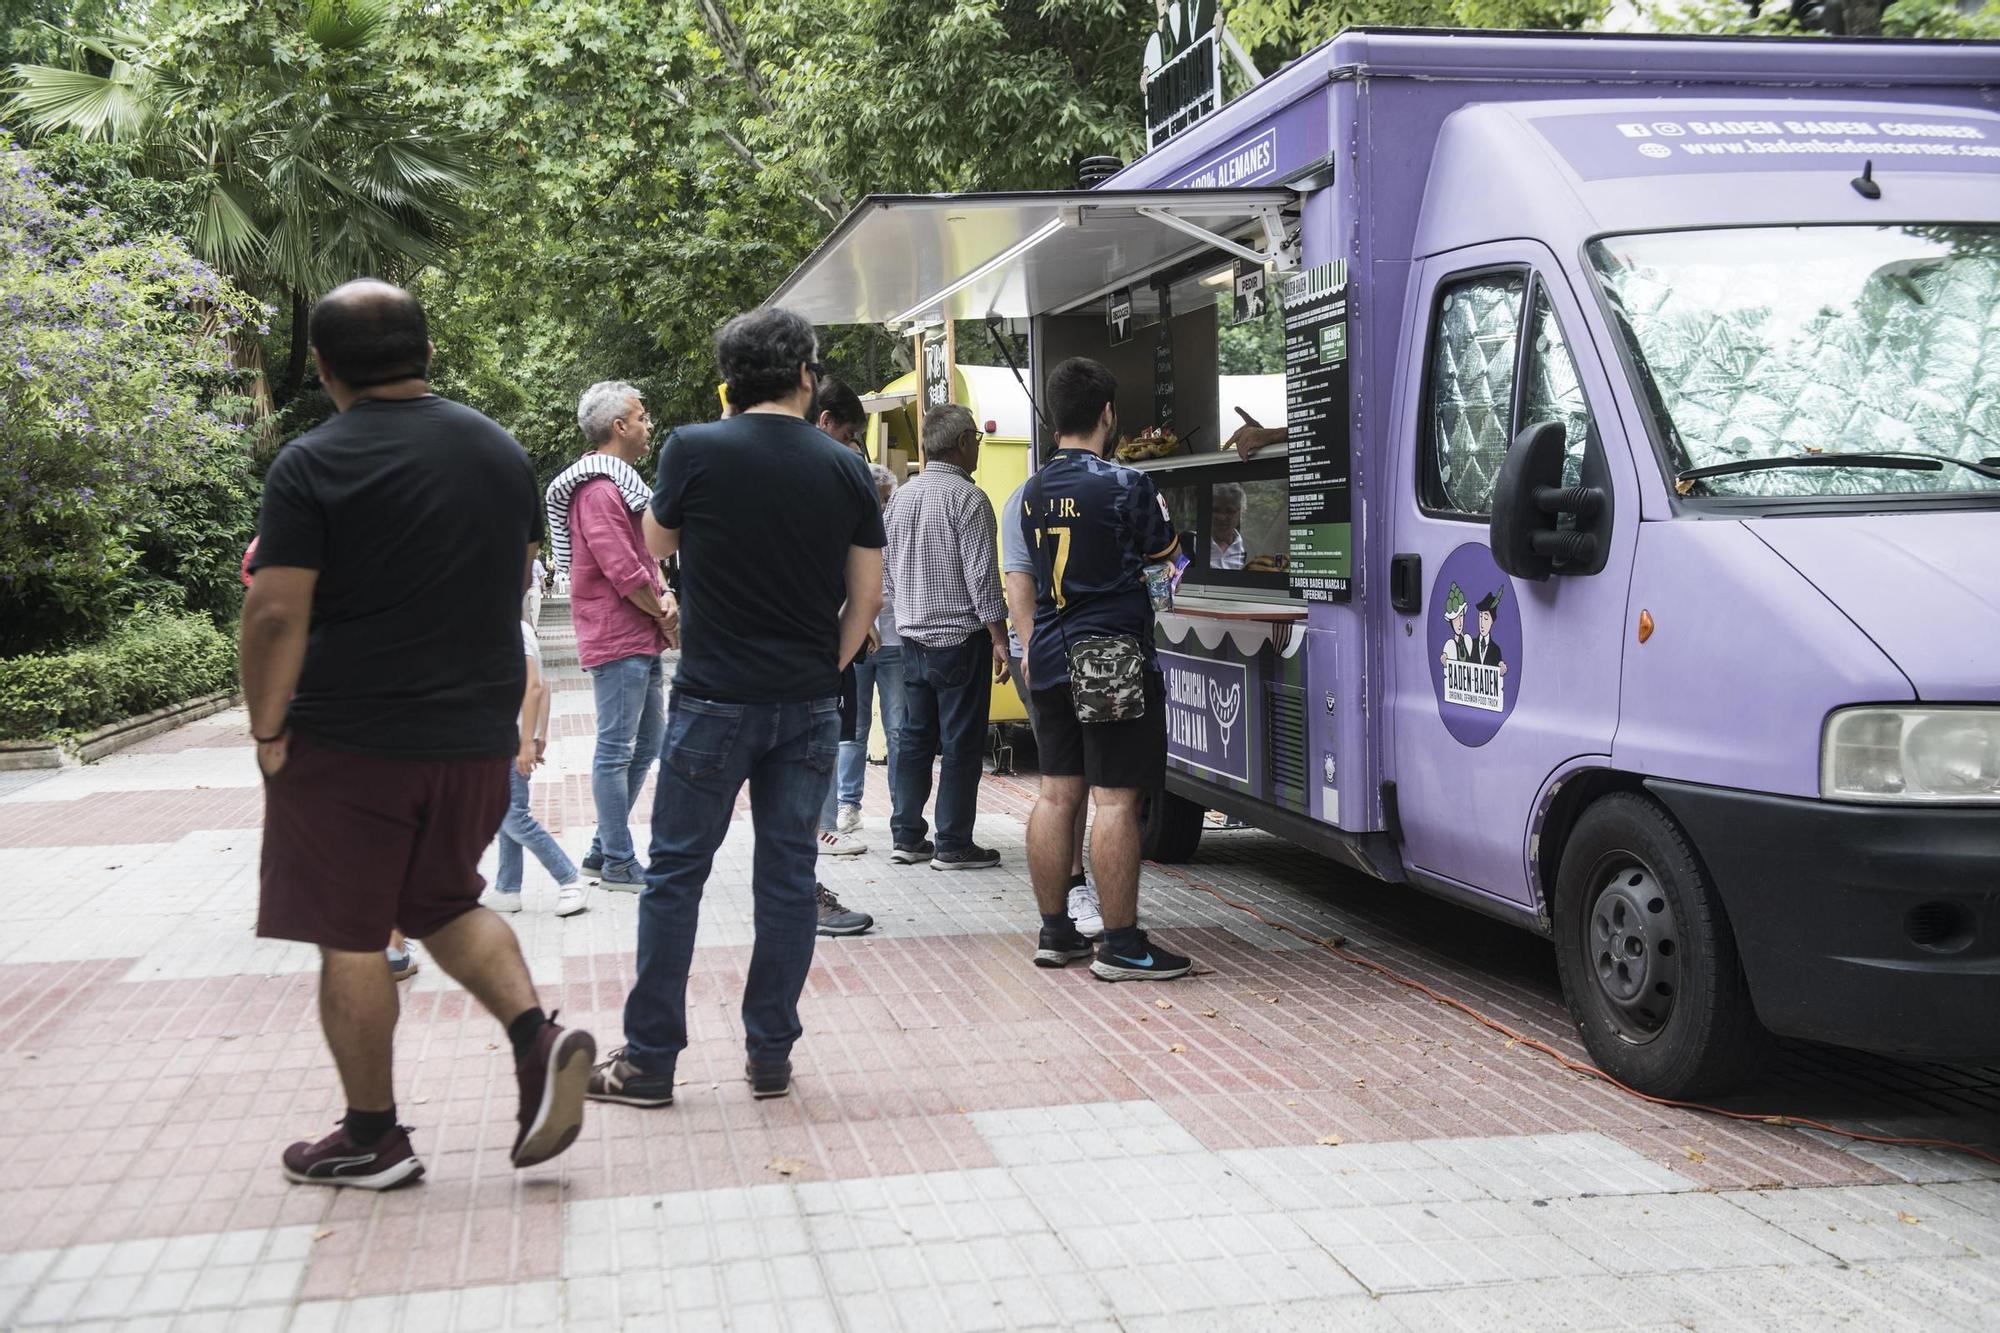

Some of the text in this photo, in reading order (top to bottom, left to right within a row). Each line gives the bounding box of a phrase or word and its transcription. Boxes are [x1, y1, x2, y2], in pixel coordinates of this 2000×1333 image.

[1687, 120, 1986, 140] BADEN BADEN CORNER
[1218, 141, 1270, 187] ALEMANES
[1680, 139, 2000, 158] www.badenbadencorner.com
[1241, 276, 1258, 292] PEDIR
[1058, 498, 1080, 517] JR.
[1034, 527, 1071, 609] 7
[1170, 667, 1207, 710] SALCHICHA
[1448, 663, 1499, 697] BADEN-BADEN
[1172, 707, 1208, 753] ALEMANA
